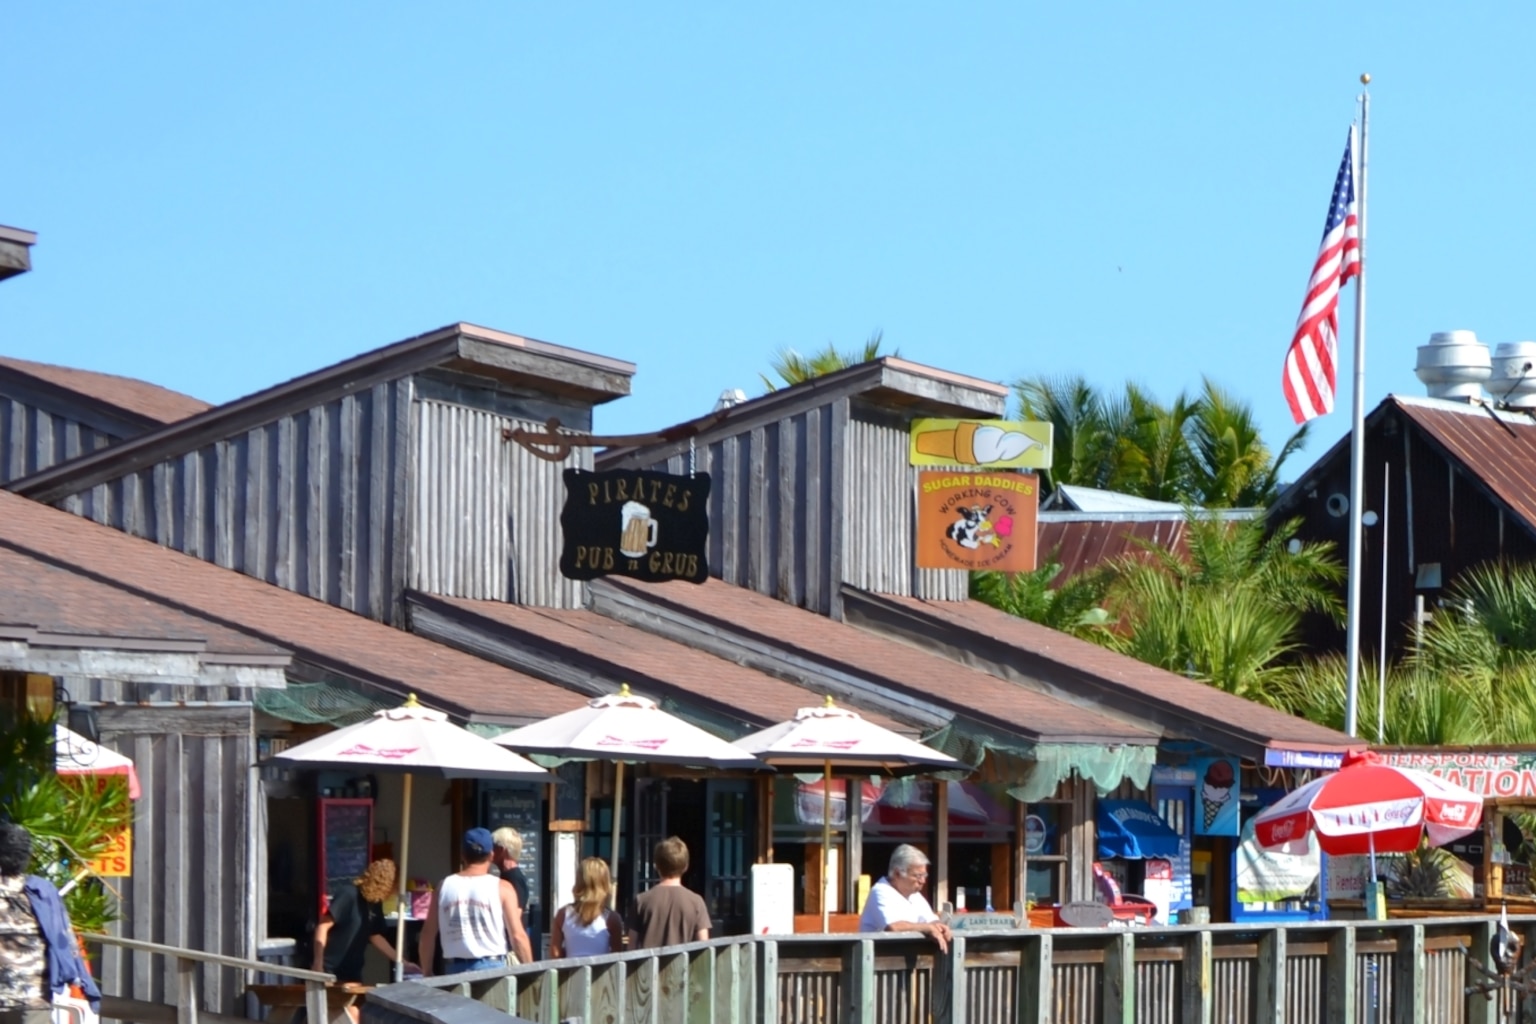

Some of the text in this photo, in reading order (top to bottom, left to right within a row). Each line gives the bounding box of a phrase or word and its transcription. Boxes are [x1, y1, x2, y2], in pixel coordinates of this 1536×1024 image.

[588, 477, 692, 511] PIRATES
[923, 476, 1033, 496] SUGAR DADDIES
[939, 488, 1017, 517] WORKING COW
[575, 545, 615, 570] PUB
[649, 551, 698, 577] GRUB
[940, 538, 975, 567] HOMEMADE
[977, 559, 991, 567] ICE
[1374, 753, 1518, 766] TERSPORTS
